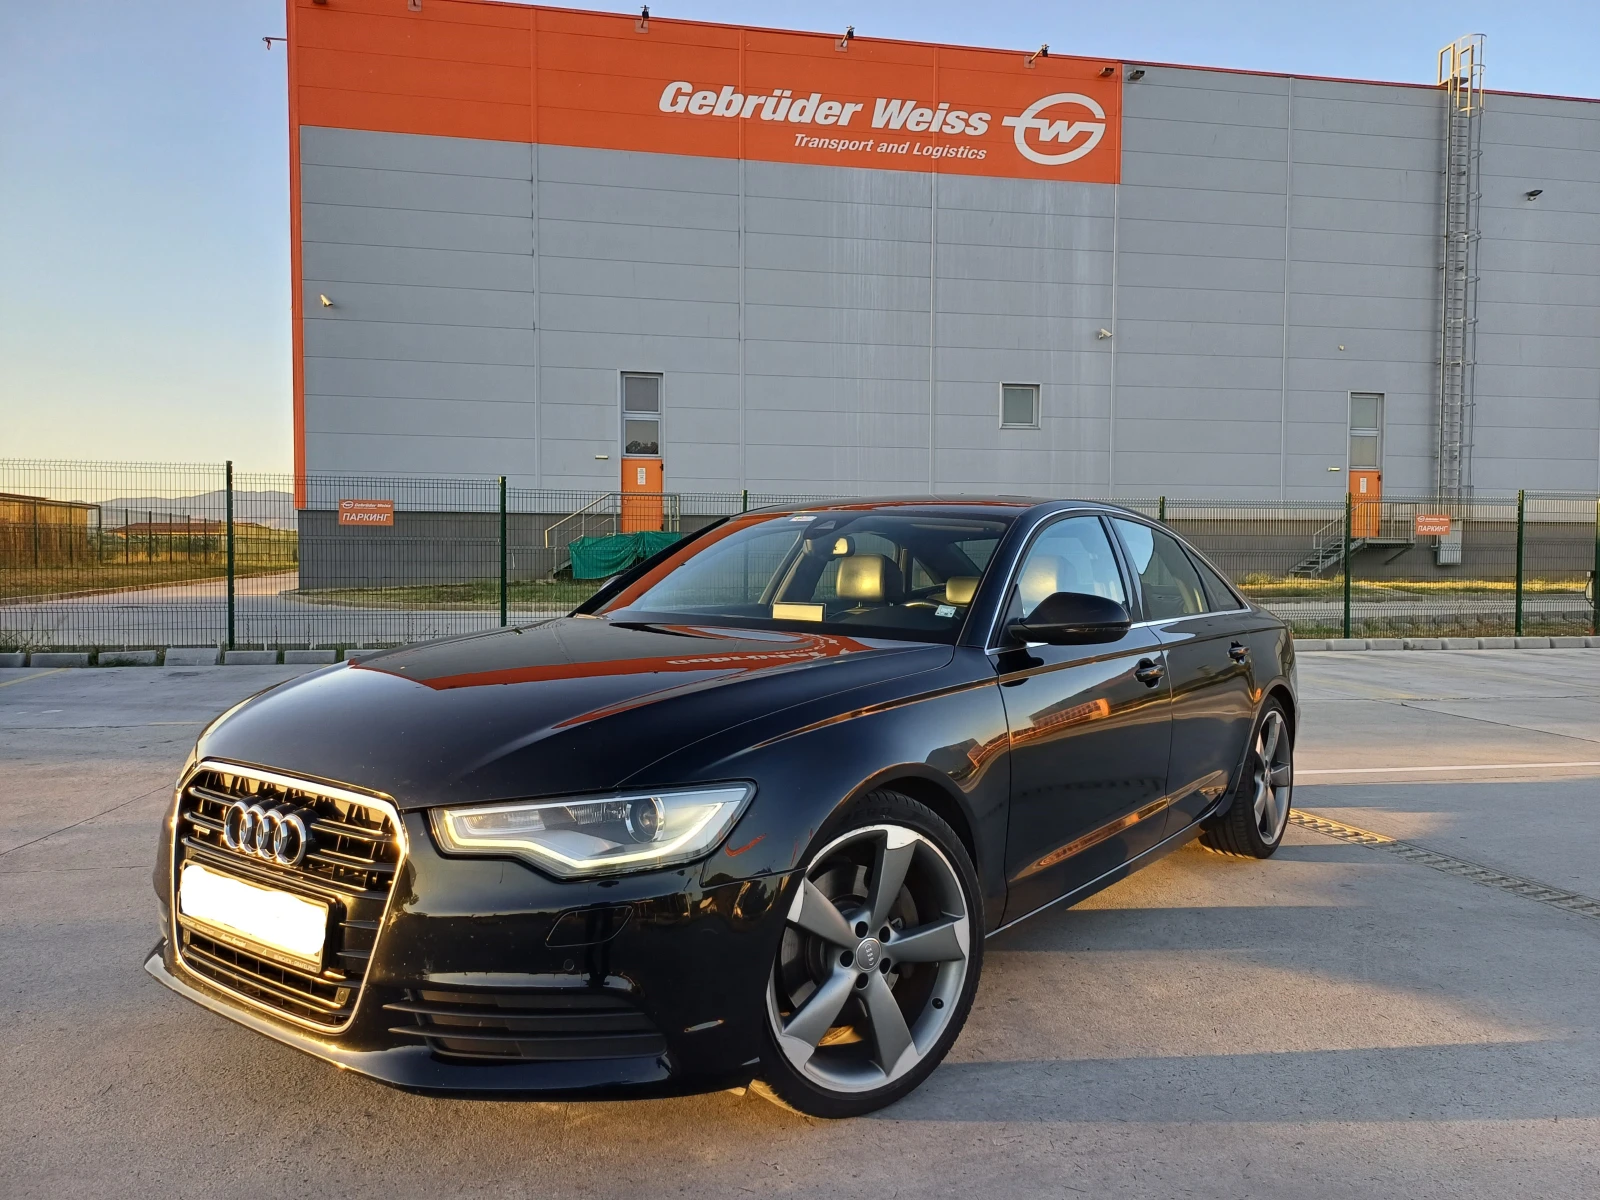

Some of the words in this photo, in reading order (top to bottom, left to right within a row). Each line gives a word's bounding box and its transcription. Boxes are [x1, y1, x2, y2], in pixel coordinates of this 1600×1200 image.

[659, 81, 864, 126] Gebrüder
[871, 98, 992, 136] Weiss
[794, 133, 874, 152] Transport
[877, 142, 910, 155] and
[913, 142, 987, 160] Logistics
[342, 513, 391, 521] ПАРКИНГ
